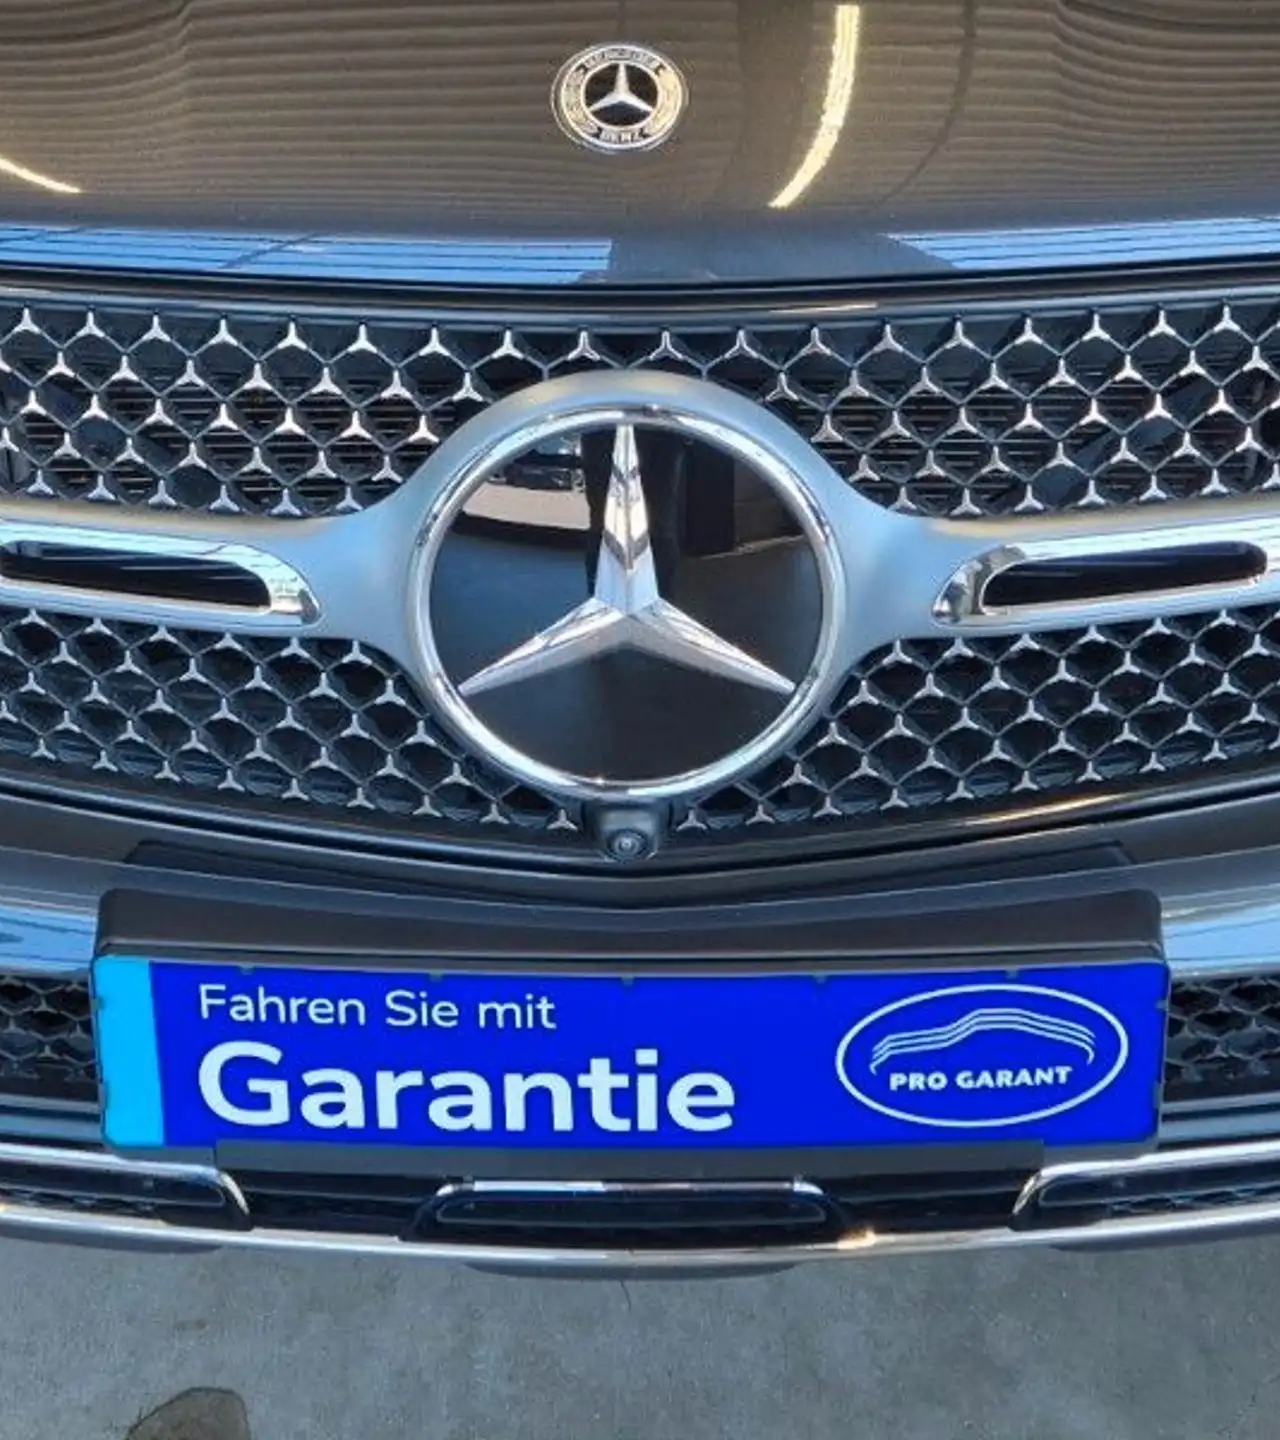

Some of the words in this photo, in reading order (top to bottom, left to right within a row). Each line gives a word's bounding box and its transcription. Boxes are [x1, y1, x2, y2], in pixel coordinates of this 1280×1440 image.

[199, 984, 366, 1025] Fahren
[385, 989, 459, 1027] Sie
[479, 993, 556, 1029] mit
[198, 1041, 735, 1132] Garantie
[889, 1071, 948, 1091] PRO
[955, 1065, 1073, 1089] GARANT
